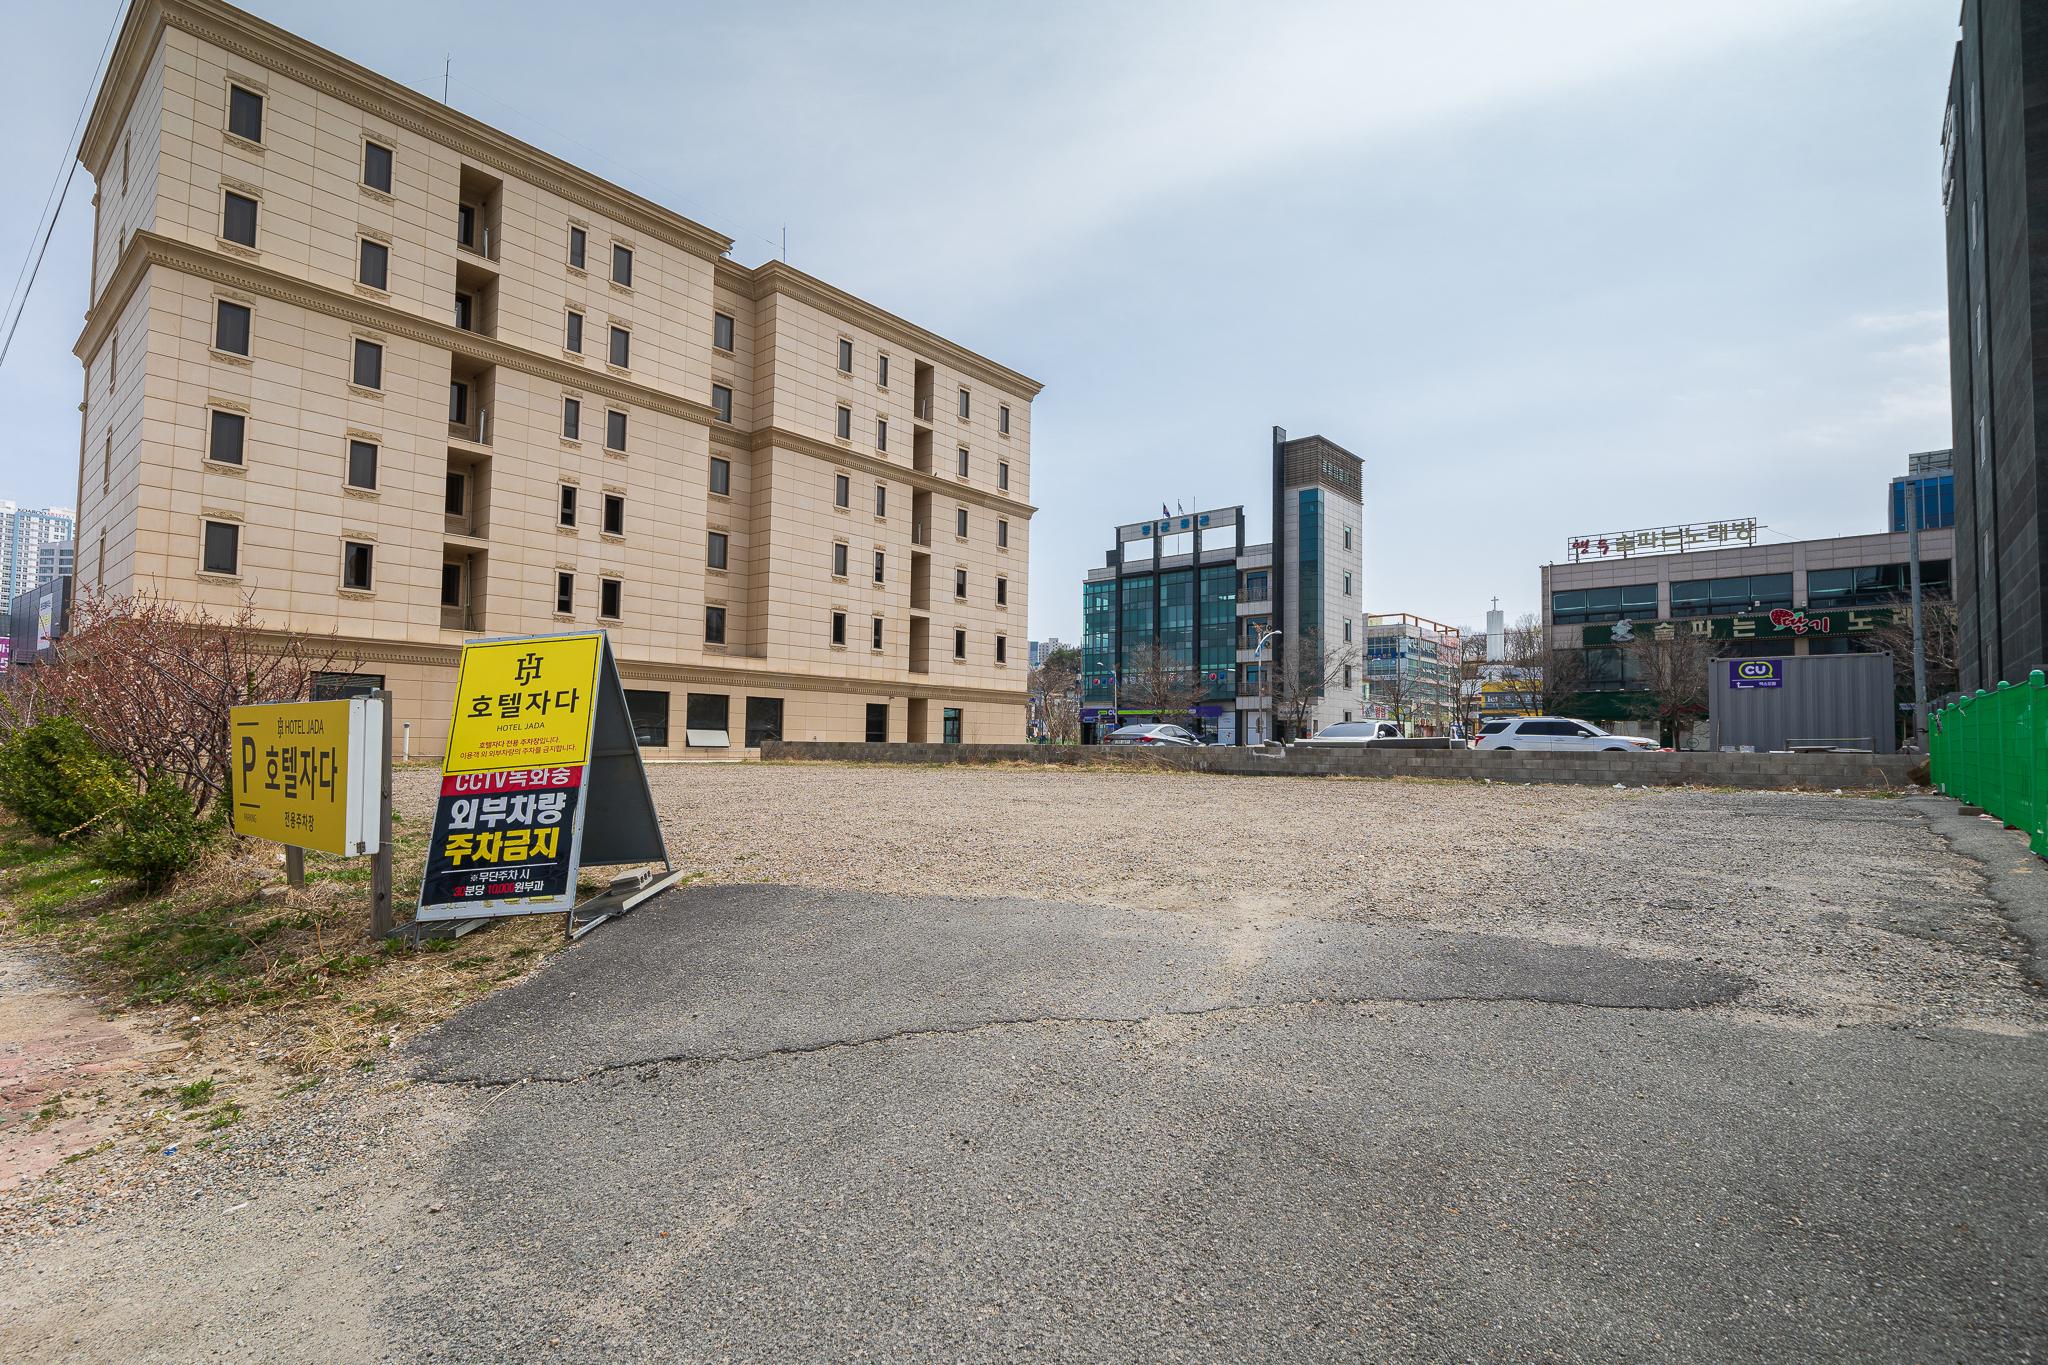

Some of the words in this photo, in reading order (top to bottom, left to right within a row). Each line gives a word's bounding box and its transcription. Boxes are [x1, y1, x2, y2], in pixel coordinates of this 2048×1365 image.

[1744, 664, 1767, 675] CU
[467, 687, 580, 720] 호텔자다
[285, 719, 306, 735] HOTEL
[306, 718, 325, 735] JADA
[496, 723, 522, 733] HOTEL
[524, 721, 545, 731] JADA
[506, 739, 519, 747] 전용
[241, 735, 257, 794] P
[459, 751, 480, 760] 이용객
[480, 750, 488, 758] 외
[264, 744, 338, 804] 호텔자다
[448, 791, 567, 831] 외부차량
[284, 811, 315, 833] 전용주차장
[444, 826, 560, 867] 주차금지
[519, 868, 531, 881] 시
